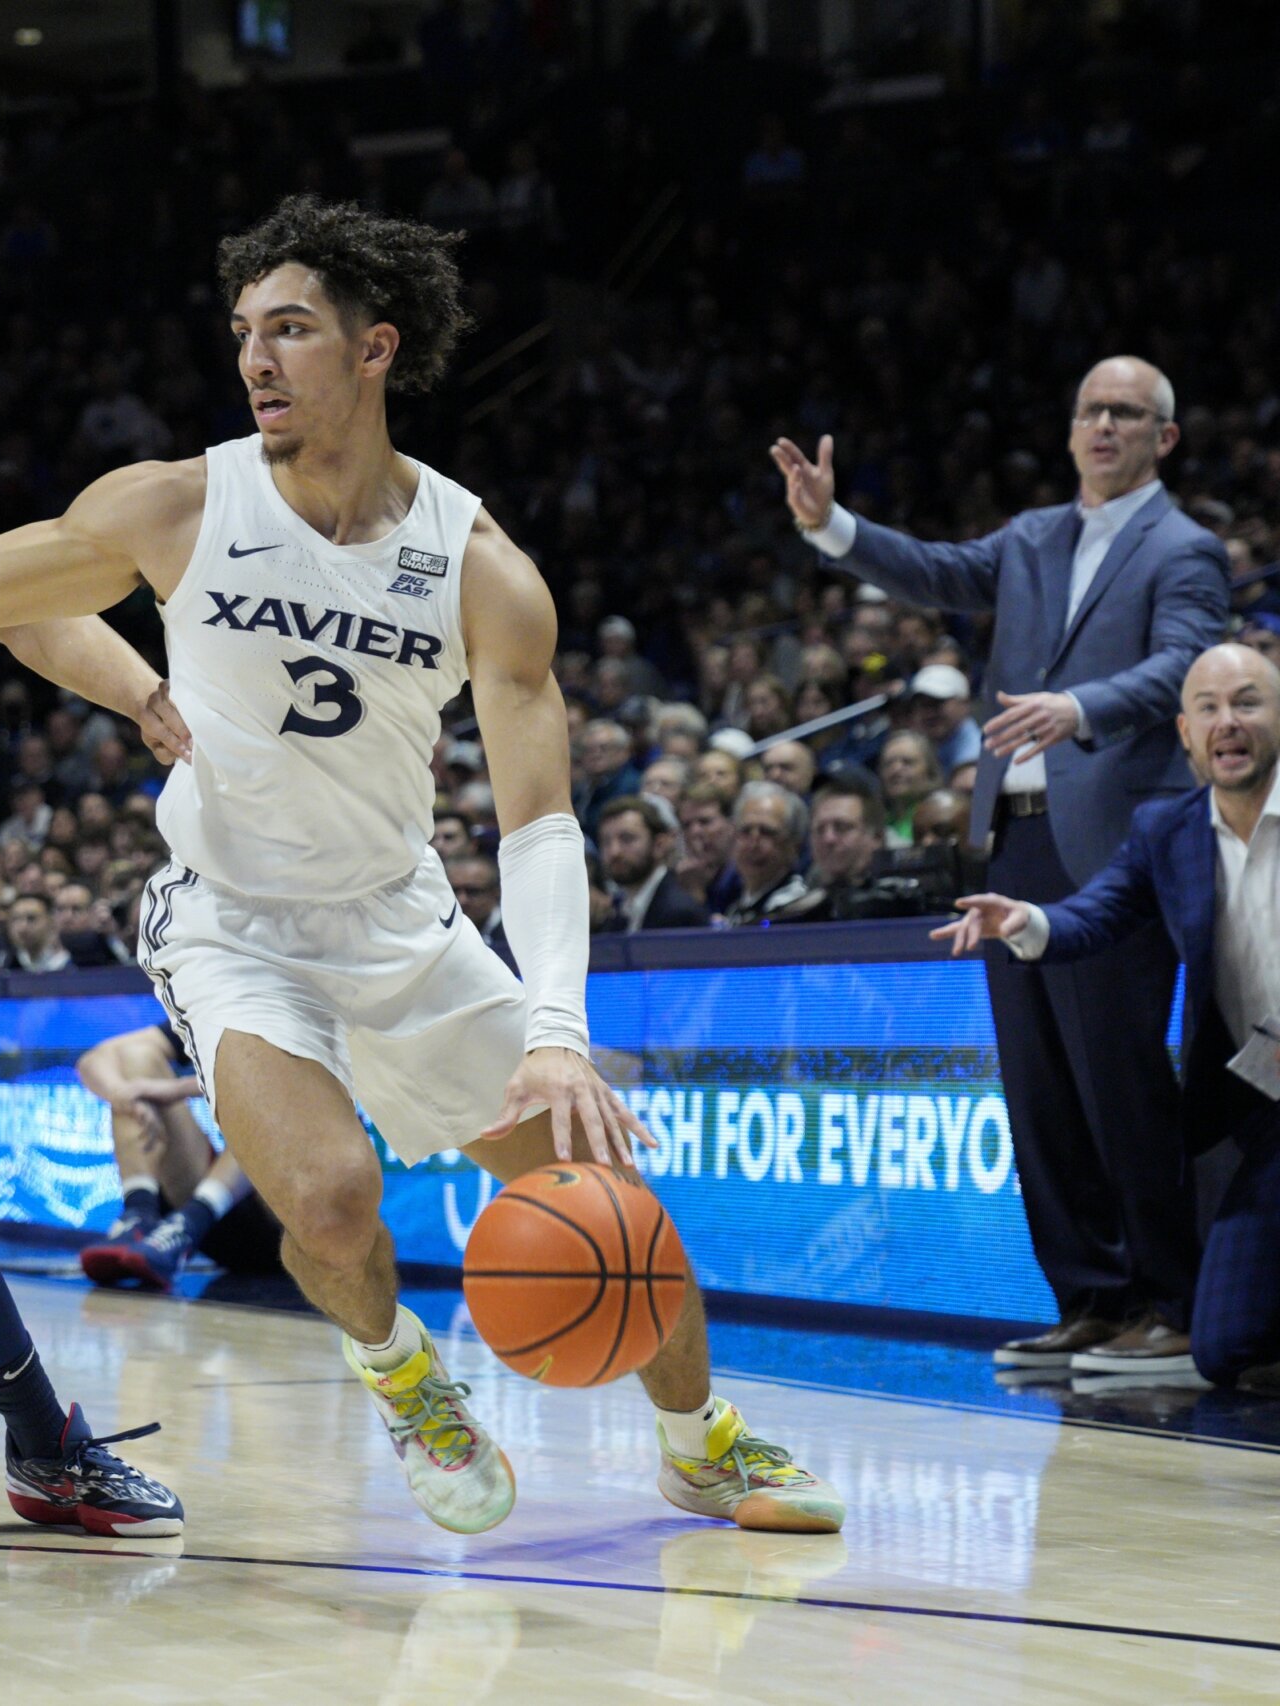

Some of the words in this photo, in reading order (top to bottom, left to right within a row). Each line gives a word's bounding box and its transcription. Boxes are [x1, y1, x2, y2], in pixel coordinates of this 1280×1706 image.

[389, 581, 433, 597] EAST
[397, 573, 428, 587] BIG
[400, 558, 446, 575] CHANGE
[201, 591, 445, 670] XAVIER
[278, 655, 366, 738] 3
[716, 1088, 805, 1183] FOR
[819, 1092, 1021, 1195] EVERYO
